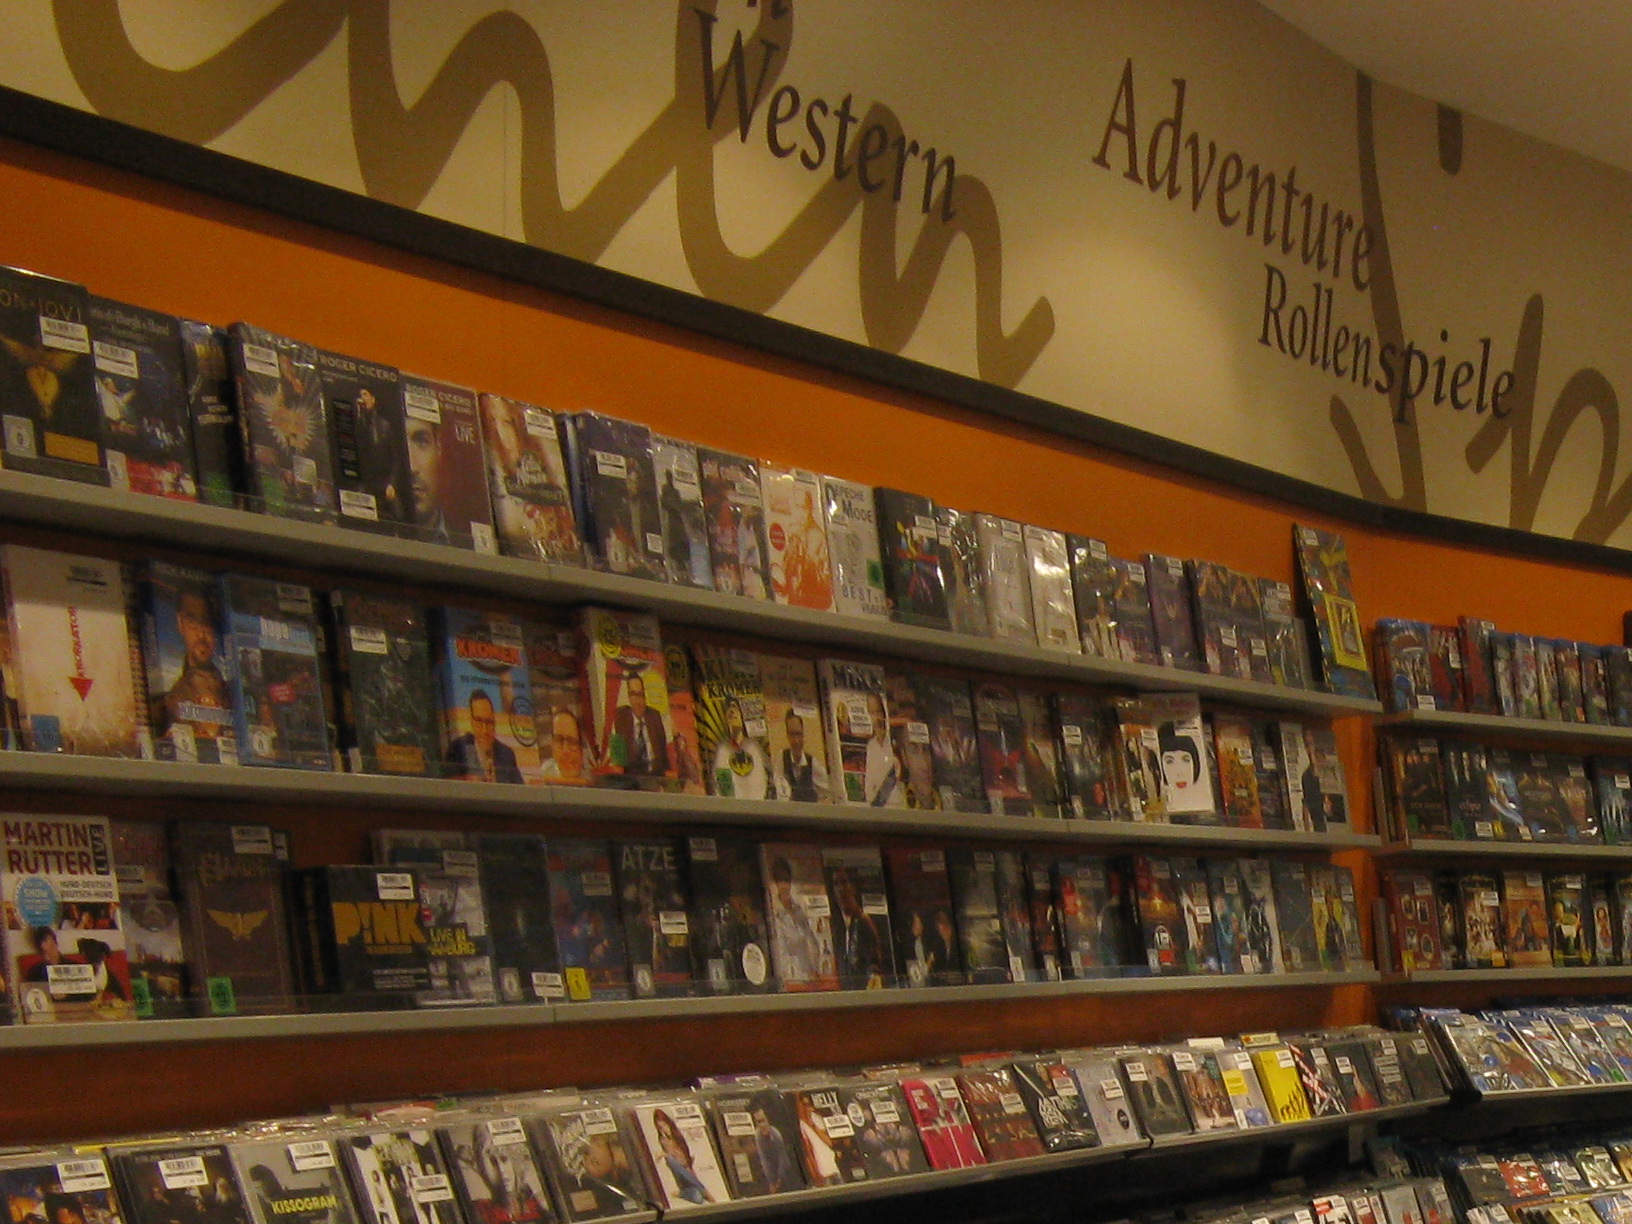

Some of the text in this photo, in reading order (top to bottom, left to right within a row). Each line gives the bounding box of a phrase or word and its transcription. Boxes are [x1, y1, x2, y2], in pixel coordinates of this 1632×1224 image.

[692, 7, 959, 223] Western
[1092, 58, 1377, 292] Adventure
[1257, 263, 1516, 425] Rollenspiele
[3, 821, 91, 848] MARTIN
[621, 845, 677, 871] ATZE
[272, 1194, 338, 1214] KISSOGRAM
